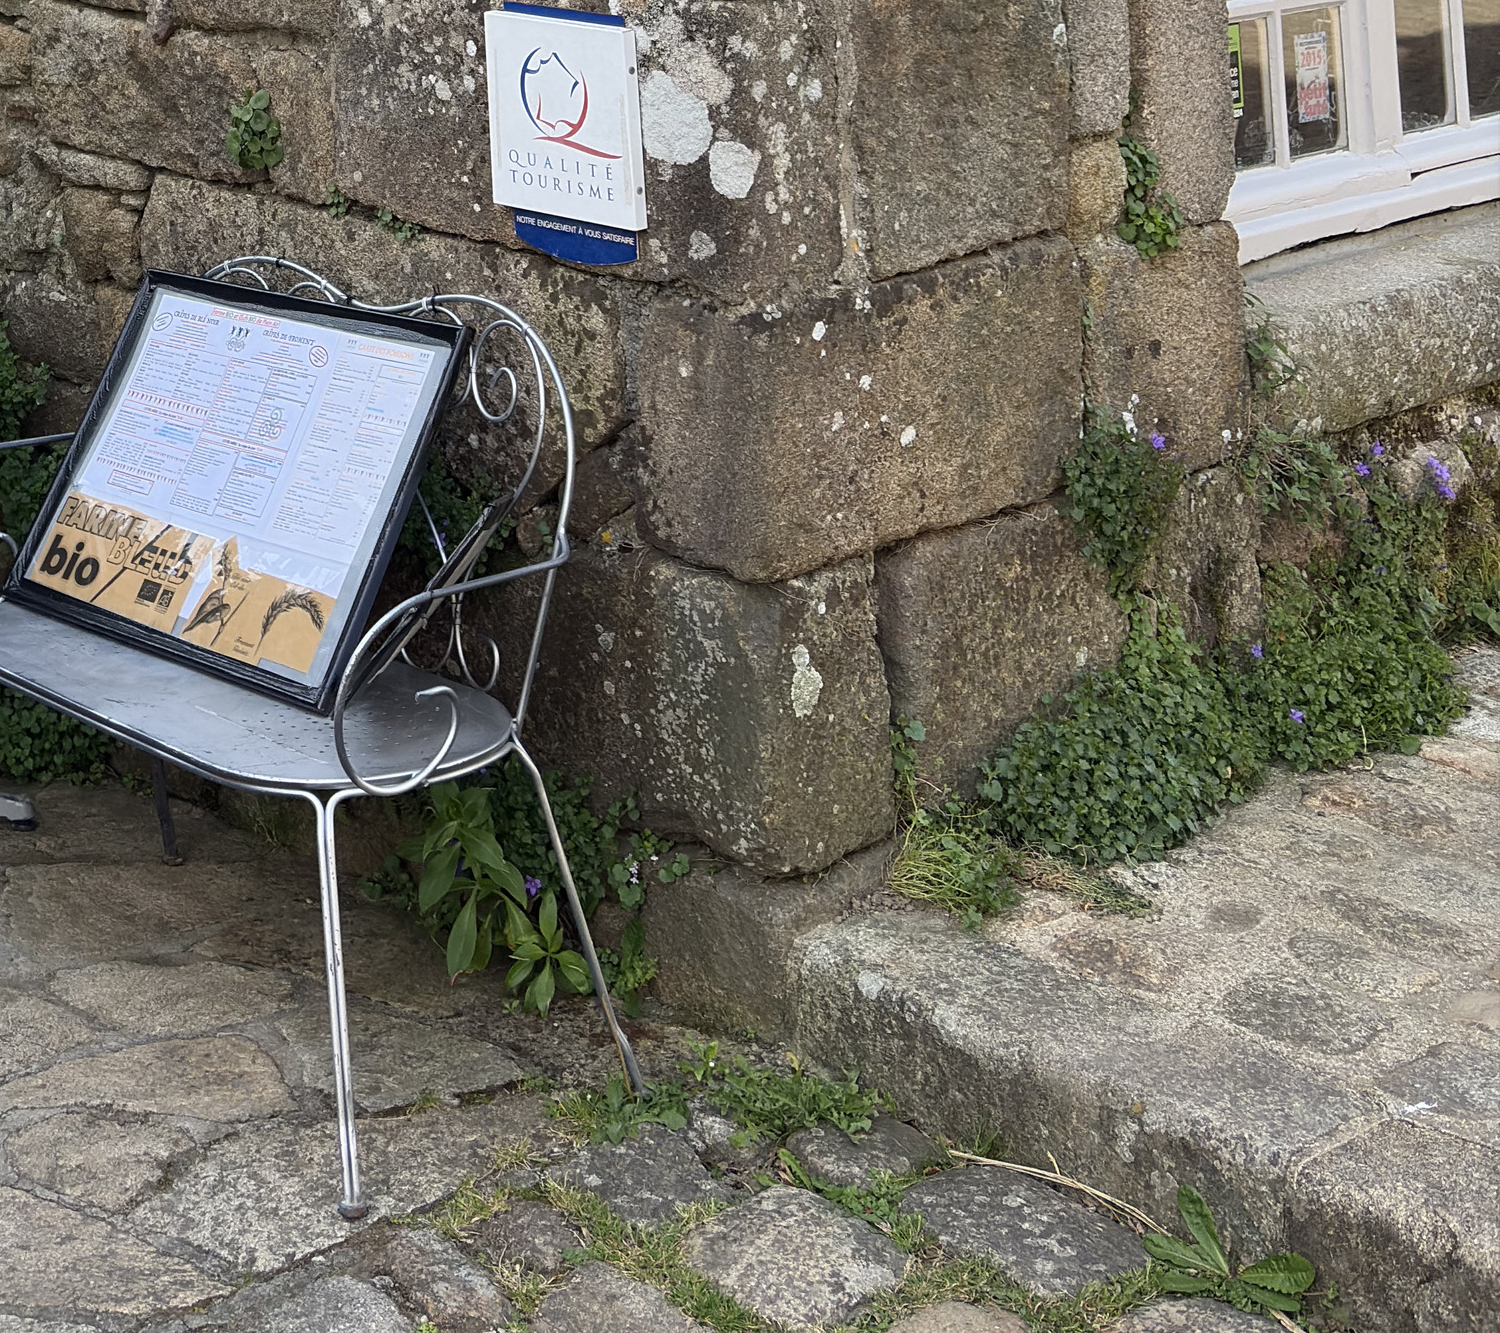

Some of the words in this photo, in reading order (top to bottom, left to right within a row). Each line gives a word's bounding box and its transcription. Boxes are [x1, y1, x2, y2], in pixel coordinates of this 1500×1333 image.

[1300, 48, 1323, 68] 2015
[508, 149, 613, 181] QUALITÉ
[509, 169, 615, 202] TOURISME
[516, 214, 536, 226] NOTRE
[536, 219, 577, 234] ENGAGEMENT
[584, 228, 602, 239] VOUS
[601, 232, 635, 246] SATISFAIRE
[38, 533, 100, 587] bio
